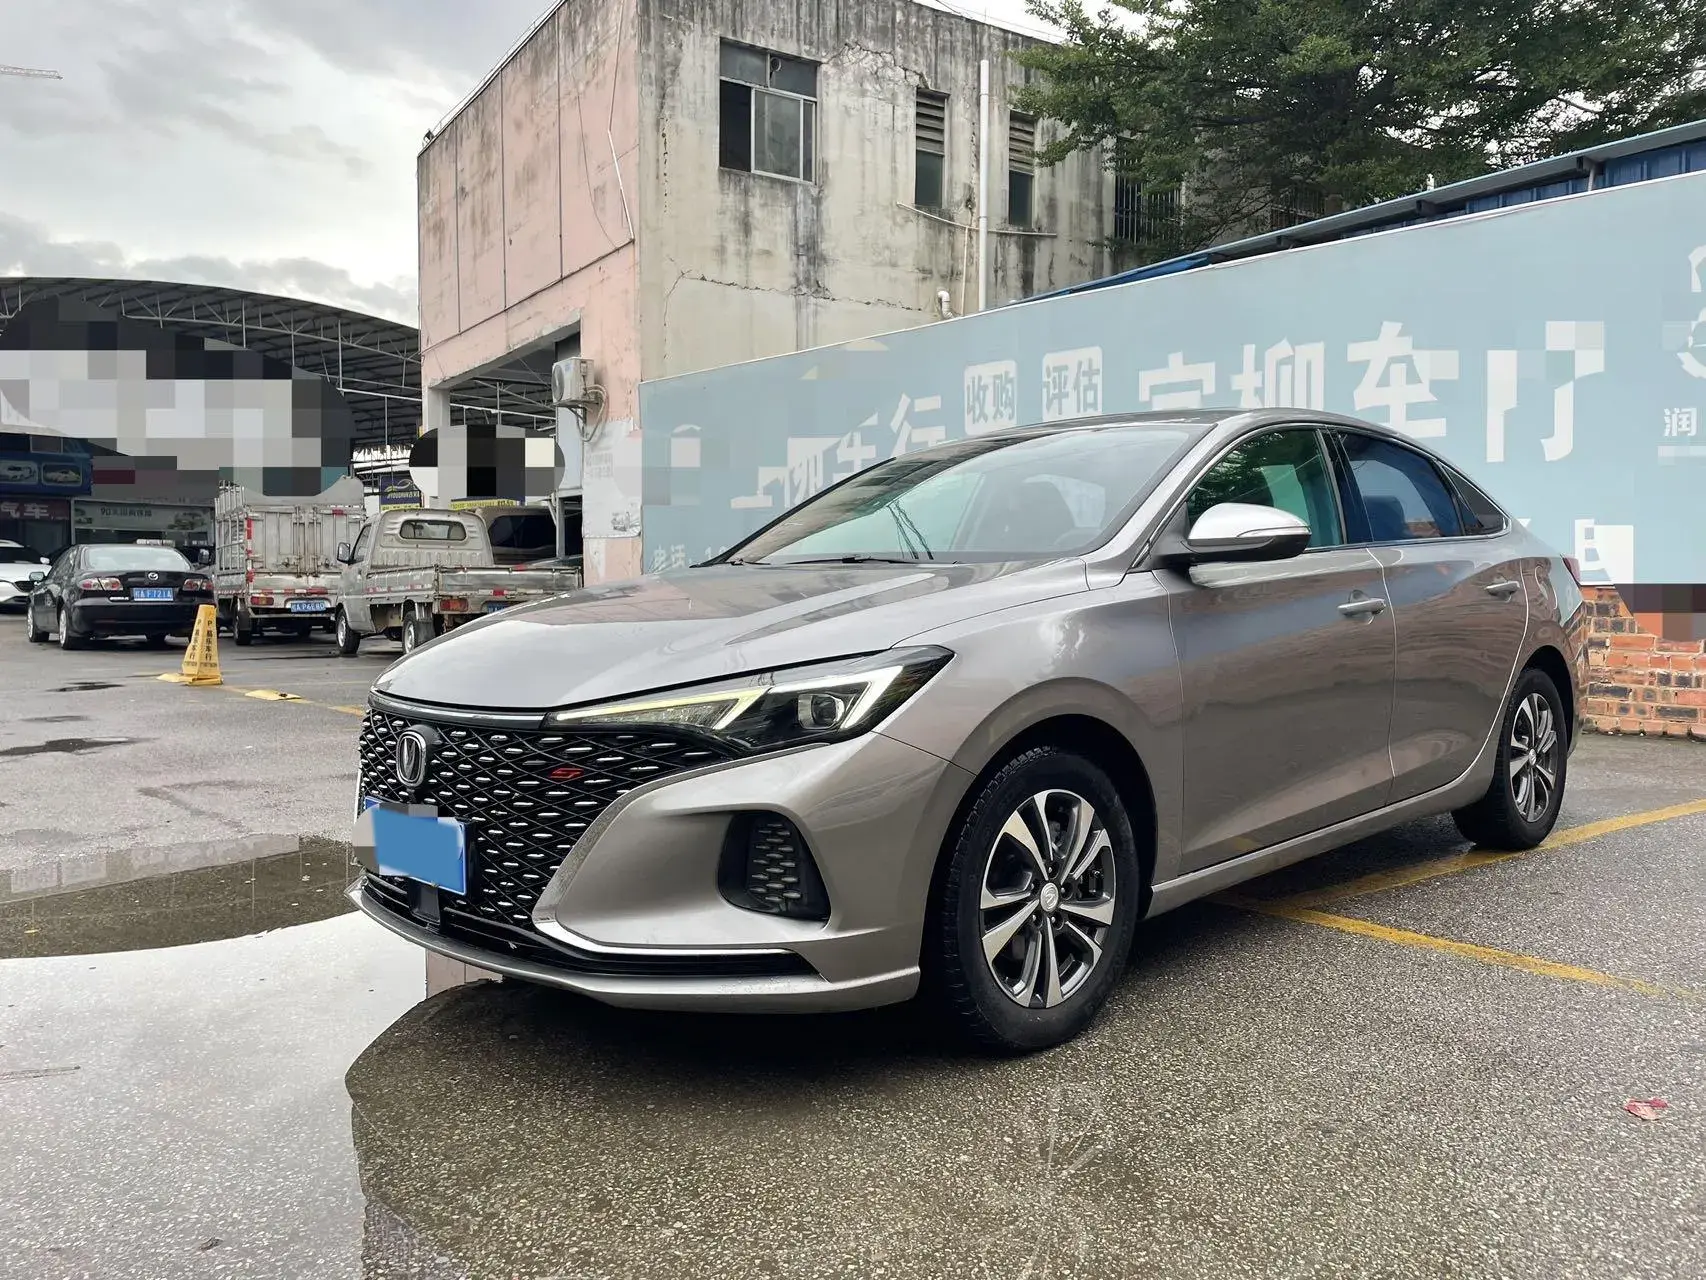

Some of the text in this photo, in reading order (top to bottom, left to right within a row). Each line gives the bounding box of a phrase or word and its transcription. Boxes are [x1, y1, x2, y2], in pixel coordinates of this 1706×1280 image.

[966, 357, 1101, 424] 收购 评估
[1664, 407, 1698, 438] 润
